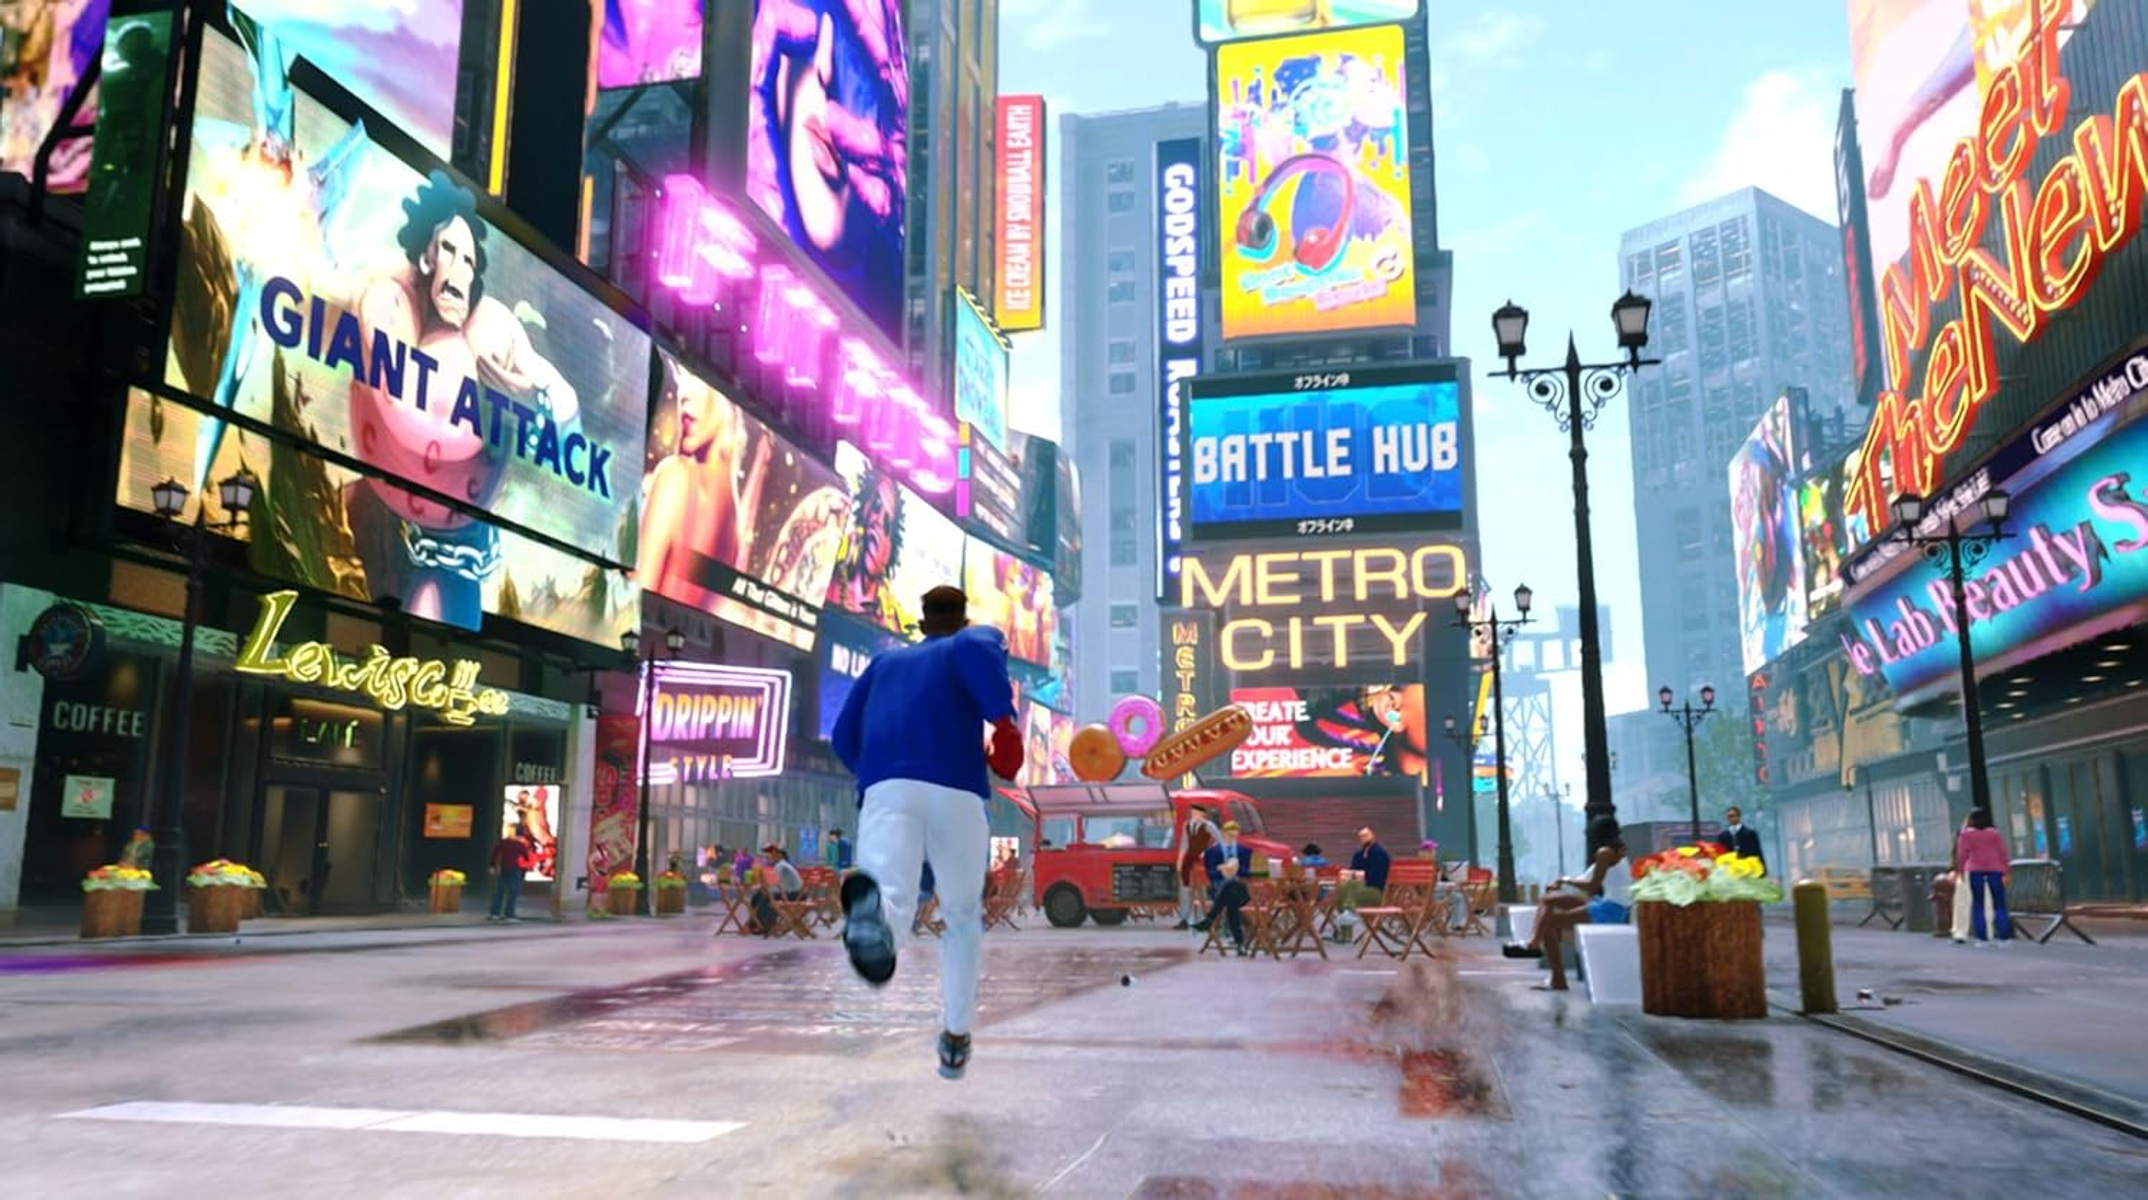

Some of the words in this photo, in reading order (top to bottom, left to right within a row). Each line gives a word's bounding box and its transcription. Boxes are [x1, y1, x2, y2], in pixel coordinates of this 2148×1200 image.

[1880, 0, 2070, 392] Meet
[1005, 243, 1032, 287] CREAM
[1164, 163, 1197, 343] GODSPEED
[1005, 288, 1032, 311] ICE
[261, 276, 438, 411] GIANT
[450, 376, 611, 498] ATTACK
[1193, 428, 1352, 484] BATTLE
[1373, 421, 1460, 474] HUB
[1843, 318, 1975, 542] The
[1182, 544, 1467, 608] METRO
[1865, 597, 1937, 664] Lab
[1926, 526, 2095, 635] Beauty
[1220, 612, 1428, 671] CITY
[53, 701, 145, 737] COFFEE
[1239, 700, 1311, 722] REATE
[1246, 724, 1293, 746] OUR
[669, 754, 733, 782] STYLE
[1231, 747, 1353, 771] EXPERIENCE
